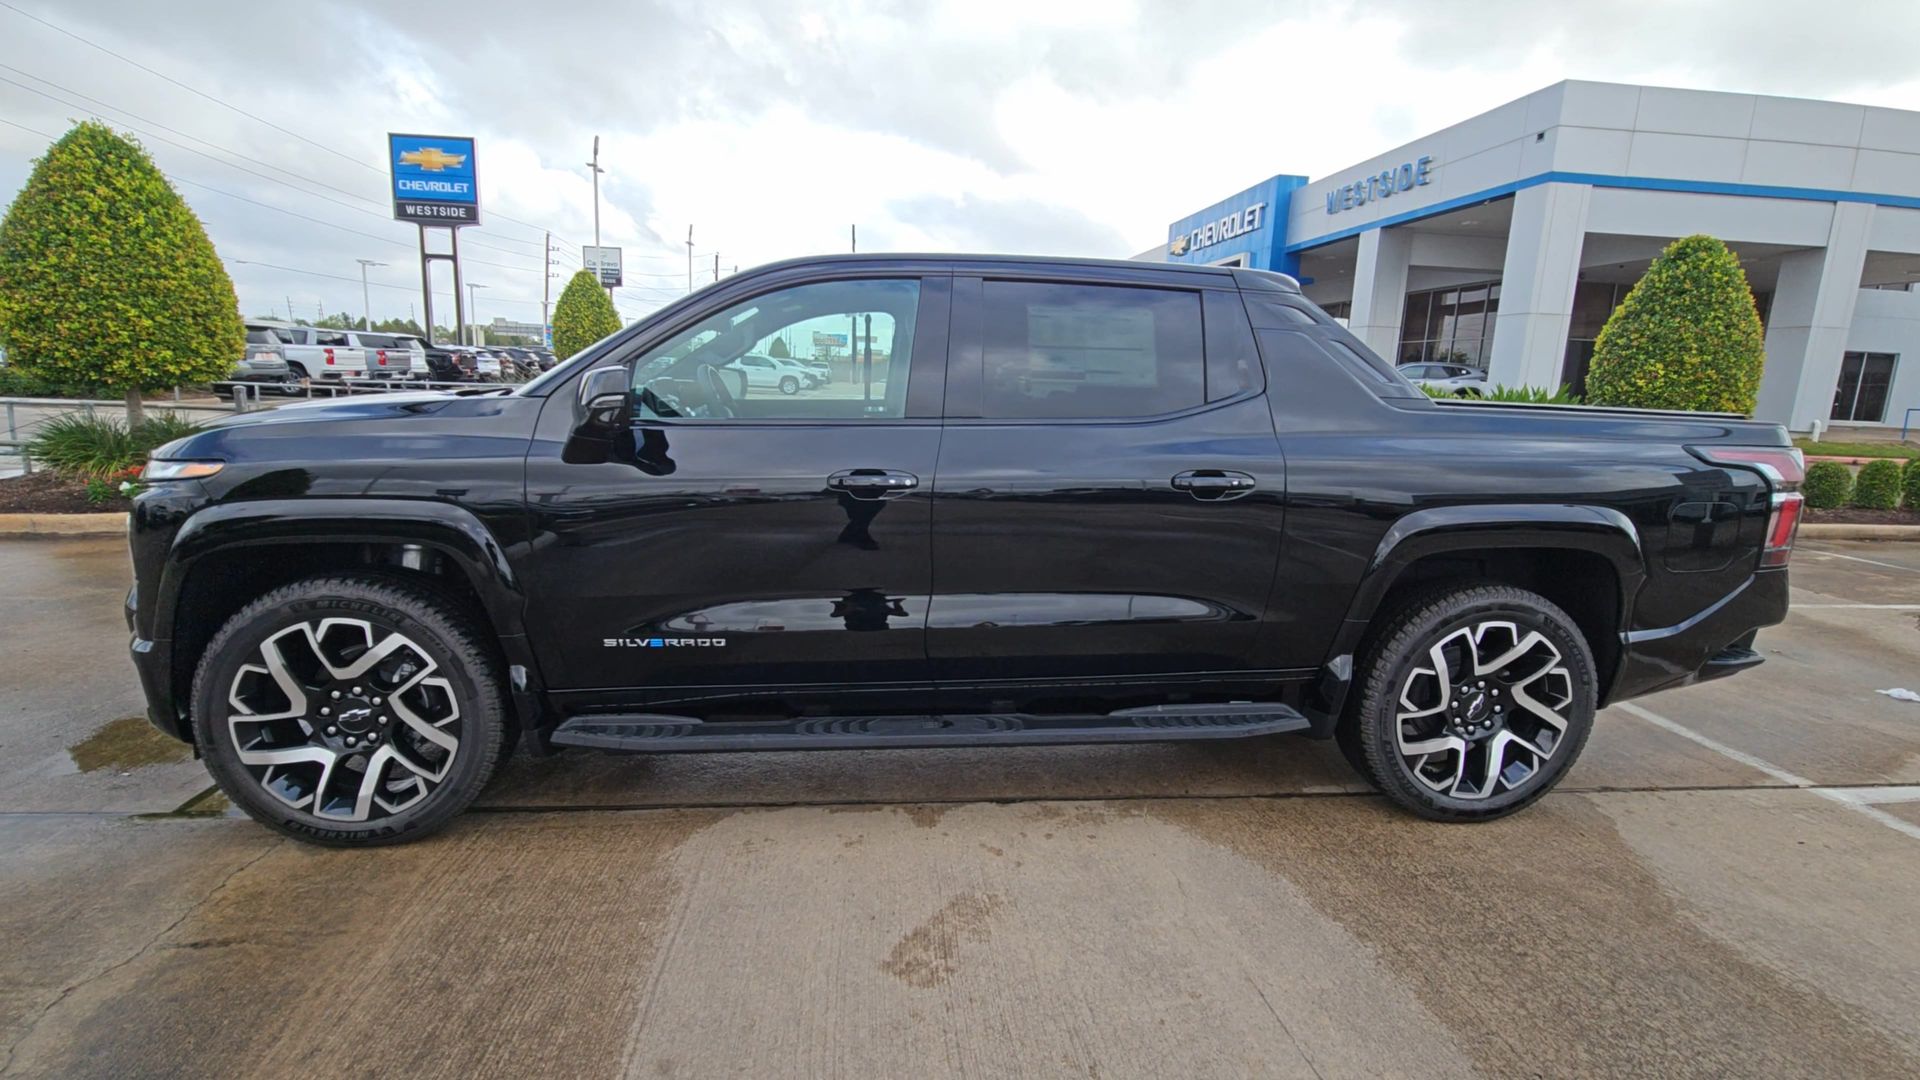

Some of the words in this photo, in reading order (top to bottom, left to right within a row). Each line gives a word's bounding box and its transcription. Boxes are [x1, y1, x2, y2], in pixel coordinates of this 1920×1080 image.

[398, 179, 469, 193] CHEVROLET
[1326, 155, 1432, 215] WESTSIDE
[405, 204, 467, 218] WESTSIDE
[1190, 202, 1266, 251] CHEVROLET
[586, 259, 619, 267] CaBravo
[315, 599, 402, 623] MICHELIN
[603, 638, 726, 647] SILVERADO
